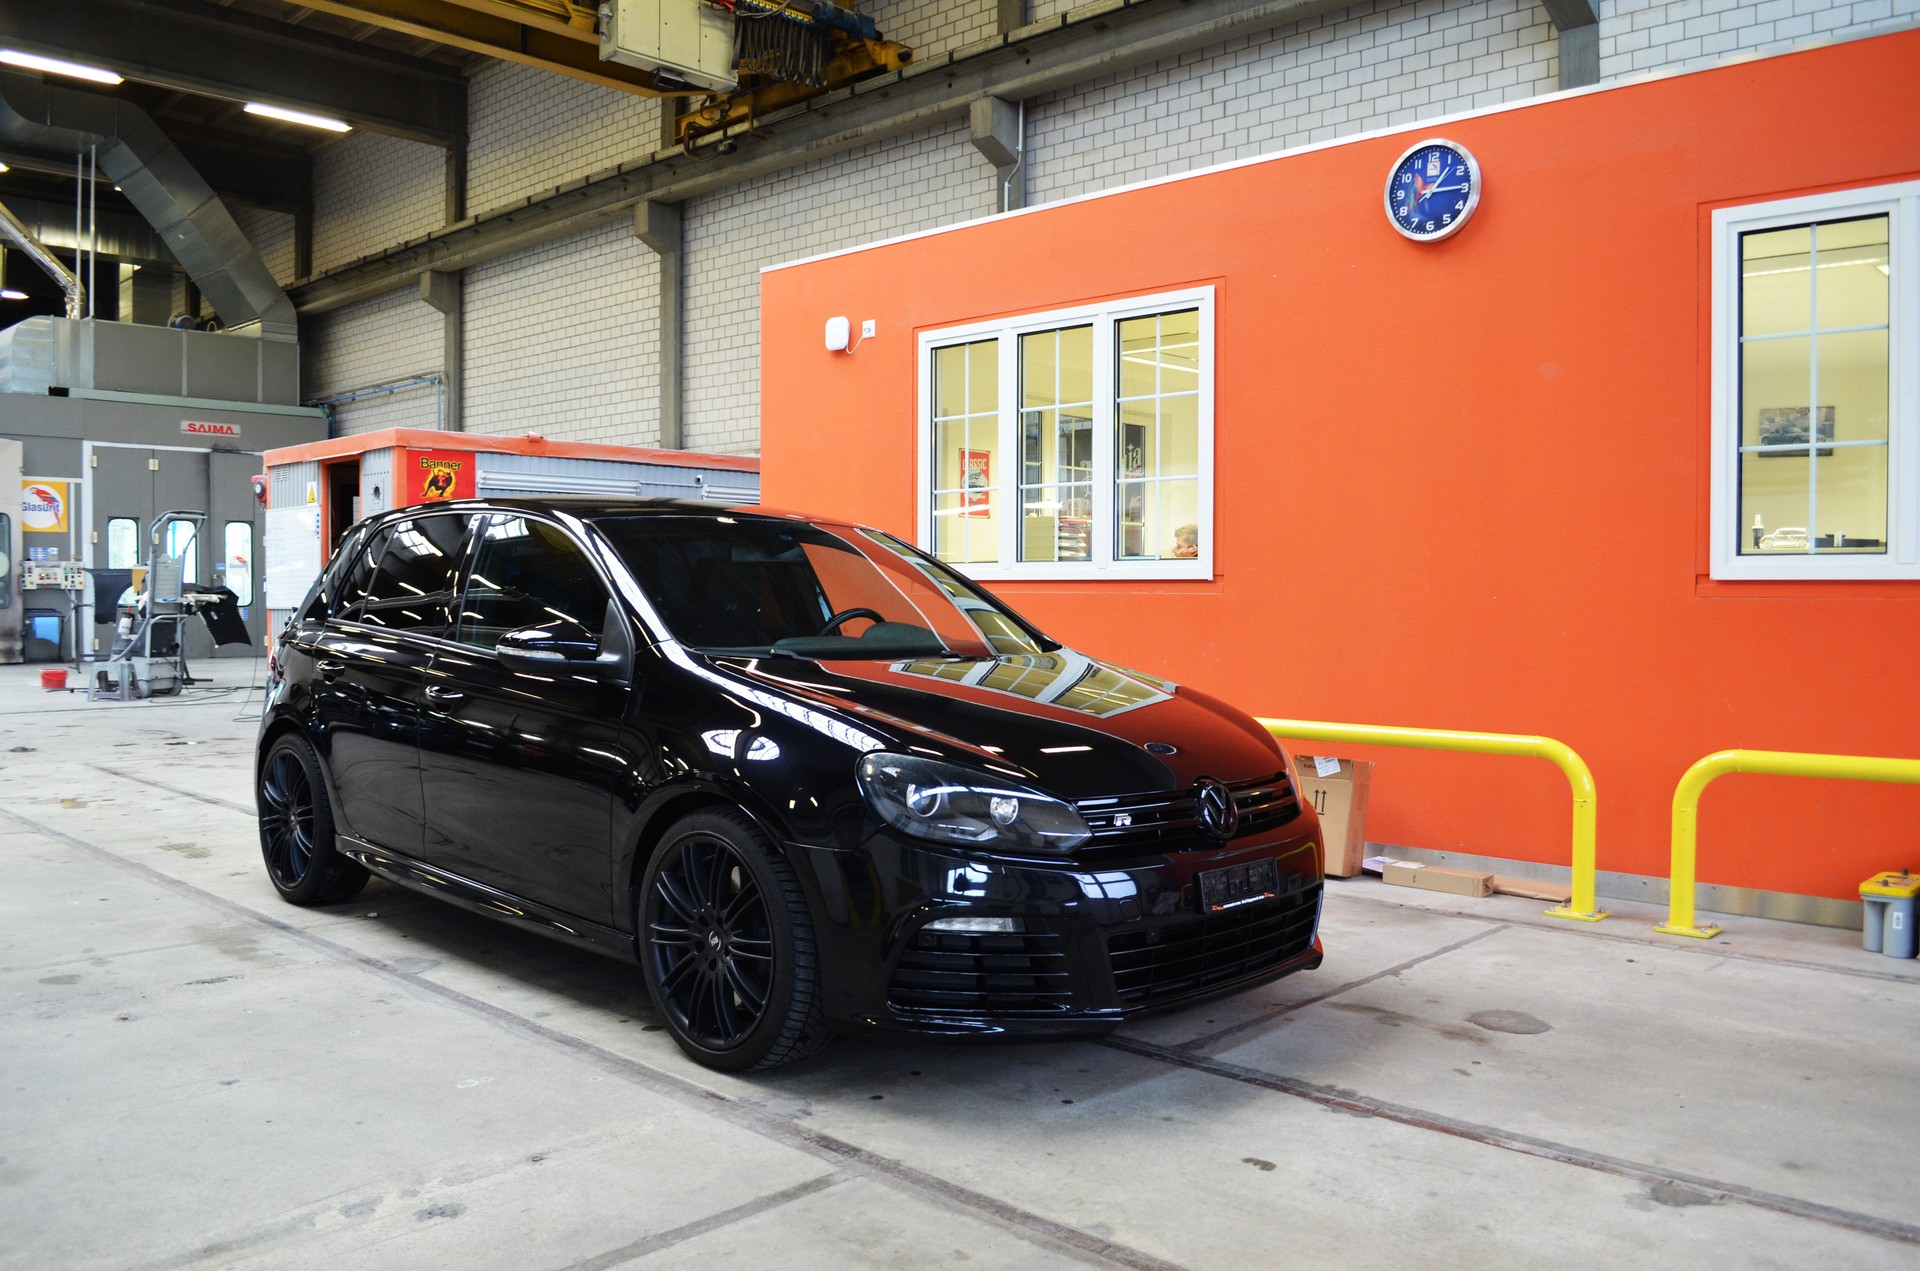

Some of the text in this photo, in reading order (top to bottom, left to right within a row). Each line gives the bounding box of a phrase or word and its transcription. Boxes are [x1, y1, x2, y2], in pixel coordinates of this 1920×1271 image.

[1428, 152, 1440, 162] 12
[1414, 159, 1422, 170] 11
[1456, 166, 1465, 176] 2
[1401, 173, 1412, 183] 10
[1460, 183, 1469, 193] 3
[1396, 190, 1405, 200] 9
[1454, 200, 1464, 210] 4
[1399, 206, 1408, 217] 8
[1411, 218, 1419, 229] 7
[1442, 213, 1451, 224] 5
[1425, 221, 1435, 231] 6
[187, 422, 235, 436] SAIMA
[420, 456, 463, 471] Banner
[963, 458, 987, 470] CASSIC
[1113, 813, 1132, 827] R
